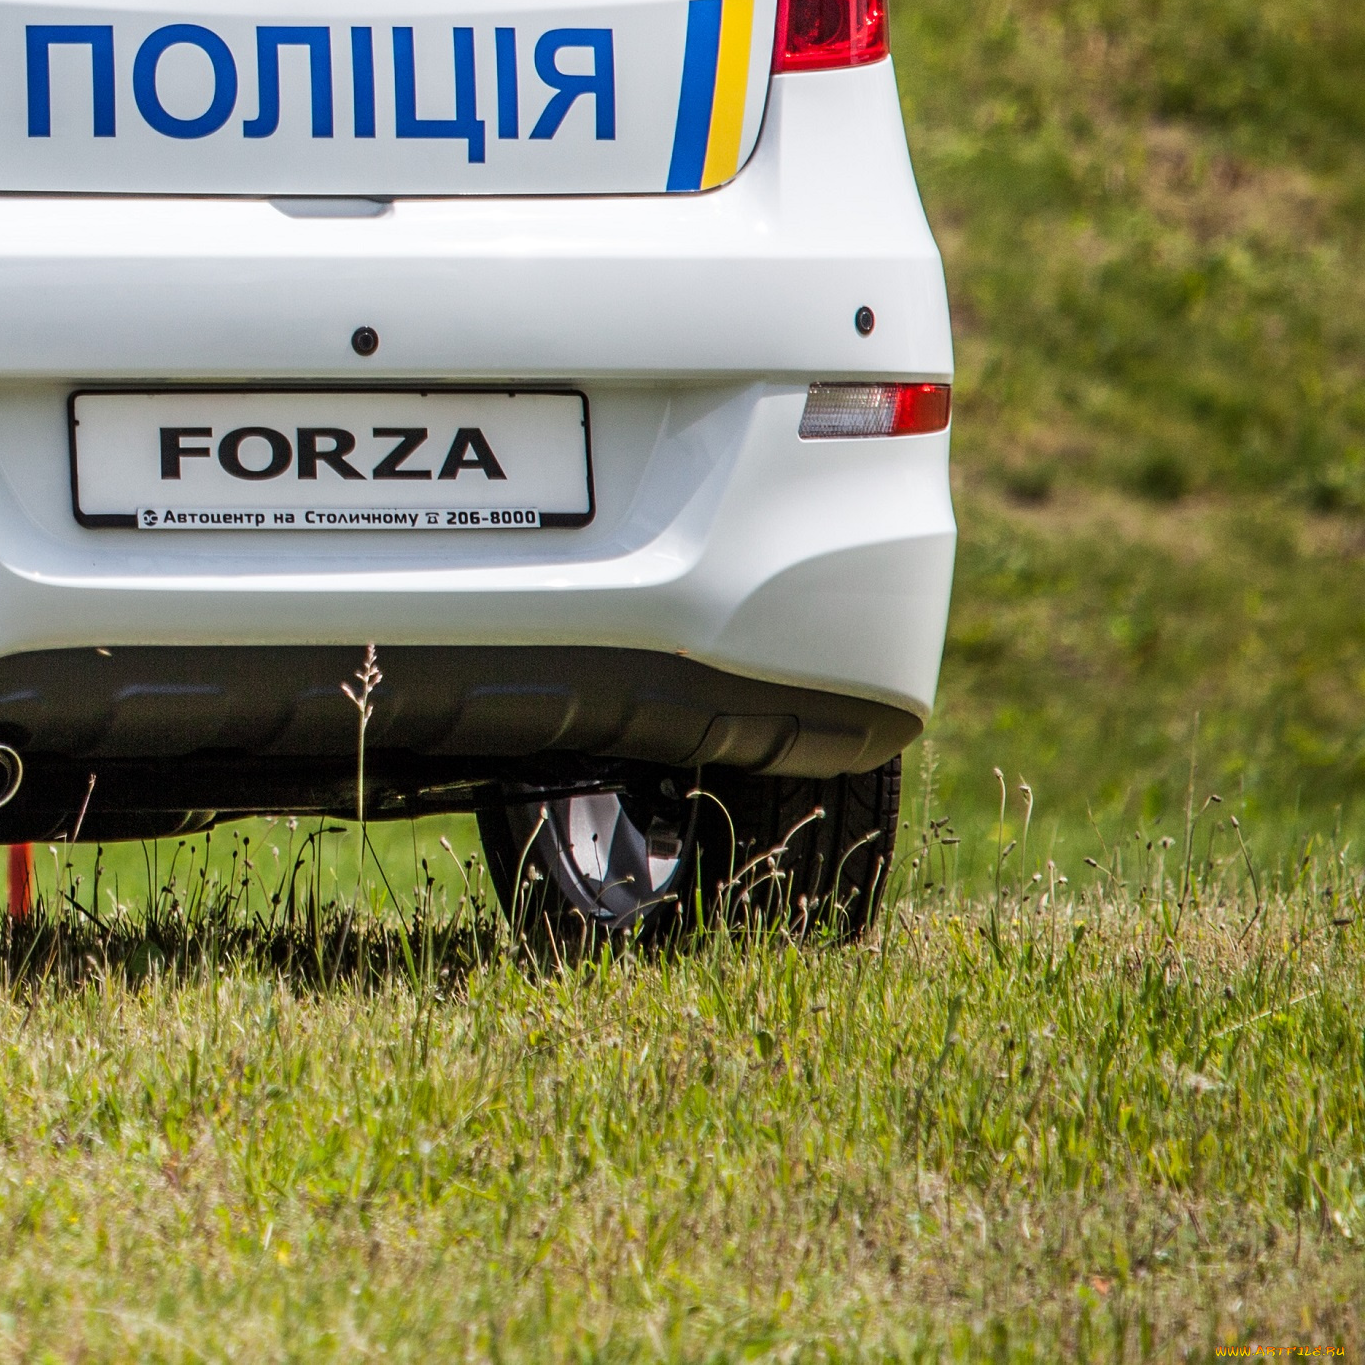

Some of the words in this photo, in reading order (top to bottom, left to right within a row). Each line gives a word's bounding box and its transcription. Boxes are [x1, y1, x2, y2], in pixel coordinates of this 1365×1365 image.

[26, 23, 616, 163] ПОЛІЦІЯ
[158, 426, 508, 481] FORZA
[163, 509, 266, 527] Автоцентр
[273, 512, 296, 524] на
[304, 510, 419, 527] Столичному
[446, 510, 537, 526] 206-8000
